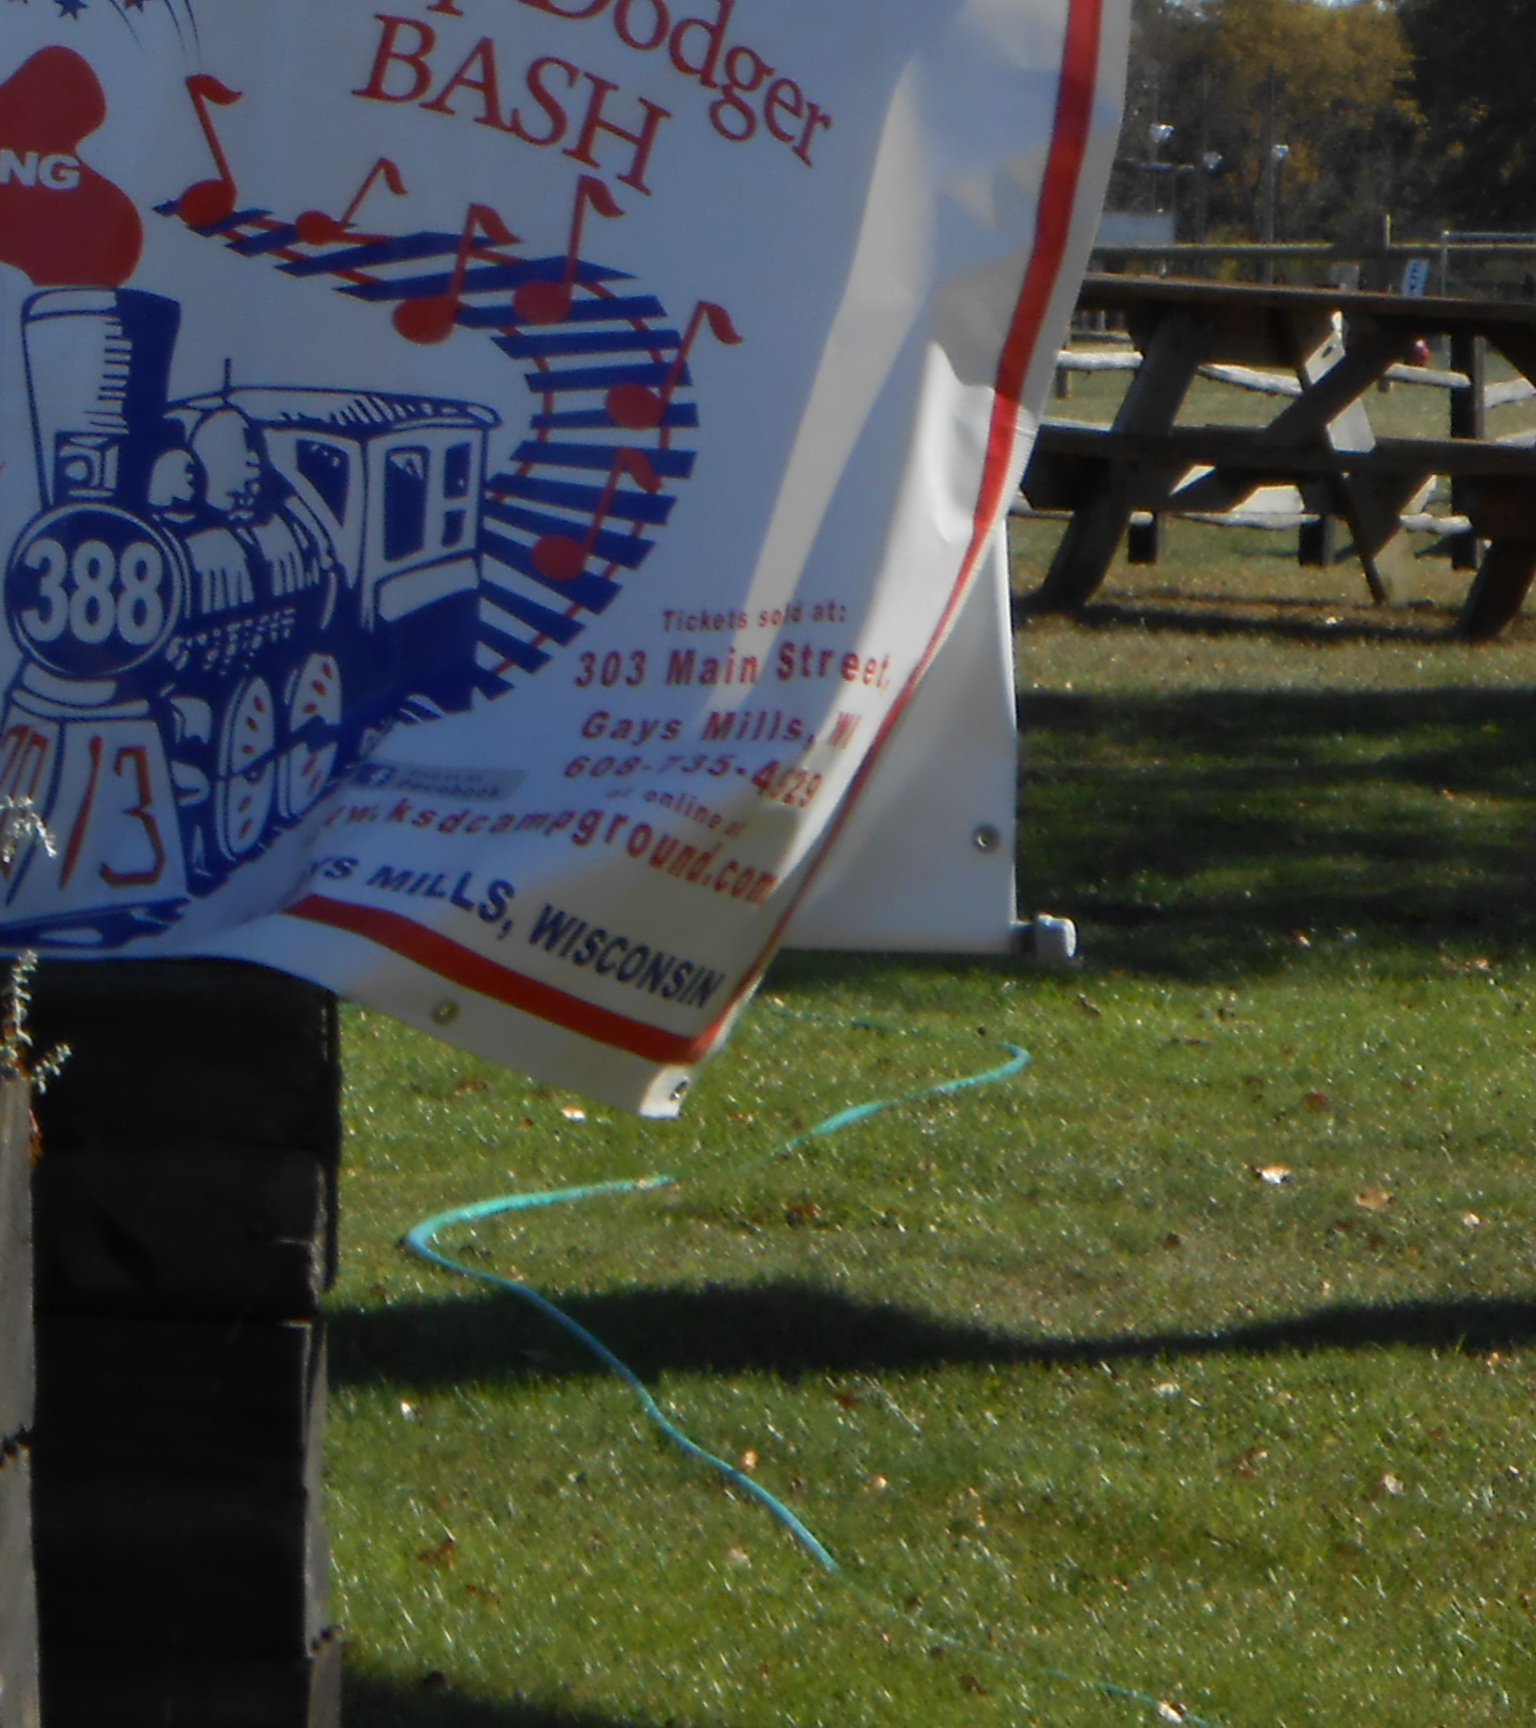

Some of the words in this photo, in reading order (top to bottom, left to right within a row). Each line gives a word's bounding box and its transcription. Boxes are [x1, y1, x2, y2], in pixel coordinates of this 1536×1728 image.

[351, 13, 672, 196] BASH
[22, 538, 164, 645] 388
[663, 608, 748, 632] Tickets
[576, 649, 647, 687] 303
[666, 648, 758, 686] Main
[582, 710, 683, 746] Gays
[701, 710, 817, 751] Mills,
[366, 865, 515, 940] MILLS,
[528, 903, 725, 1009] WISCONSIN
